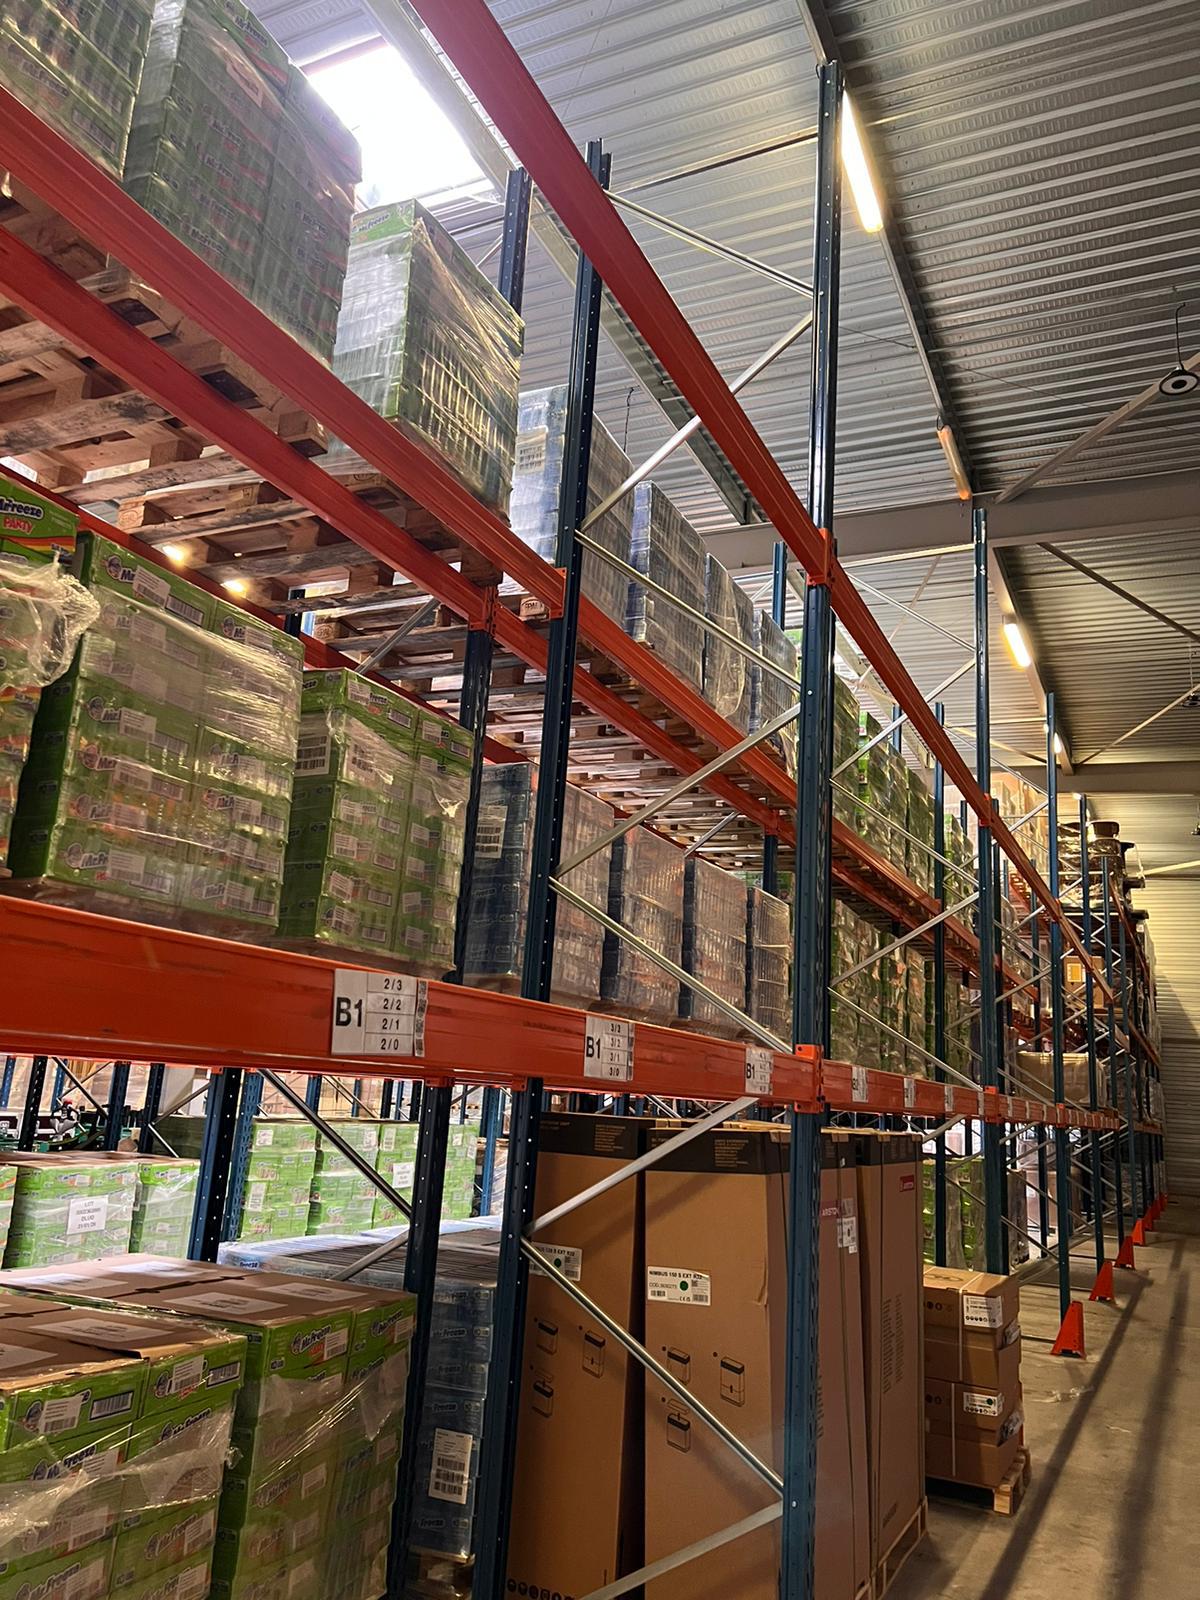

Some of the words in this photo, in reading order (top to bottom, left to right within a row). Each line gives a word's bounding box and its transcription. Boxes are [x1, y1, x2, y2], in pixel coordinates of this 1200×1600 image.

[384, 978, 403, 991] 2/3
[383, 998, 402, 1011] 2/2
[335, 996, 363, 1028] B1
[382, 1018, 400, 1030] 2/1
[380, 1038, 399, 1051] 2/0
[586, 1036, 601, 1059] B1
[609, 1066, 620, 1077] 3/0
[746, 1062, 756, 1079] B1
